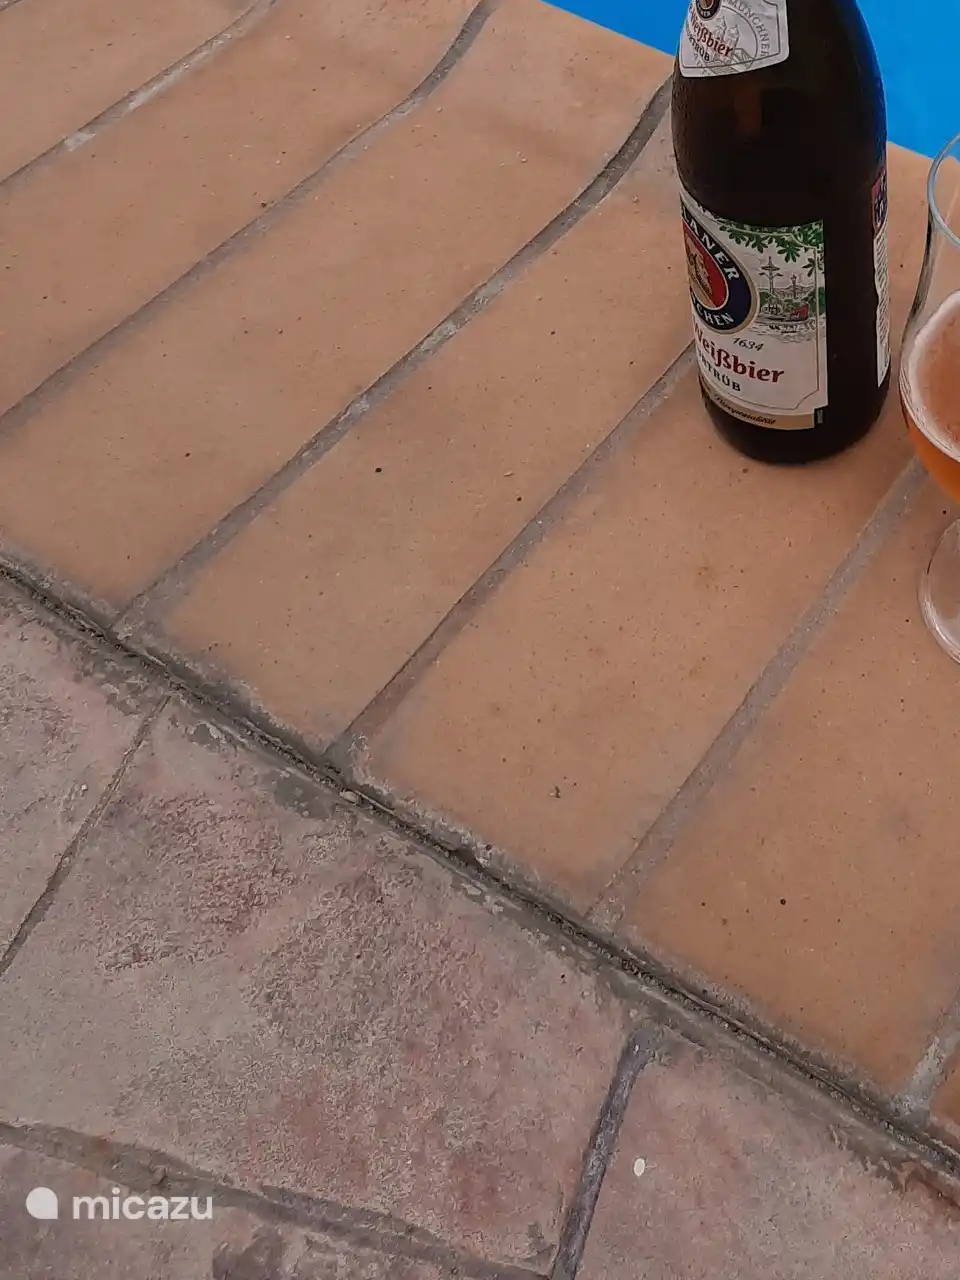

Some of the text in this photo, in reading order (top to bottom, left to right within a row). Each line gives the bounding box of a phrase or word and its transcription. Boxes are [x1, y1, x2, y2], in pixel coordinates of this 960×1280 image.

[681, 204, 740, 281] LANER
[694, 322, 785, 383] Weißbier
[732, 337, 764, 352] 1634
